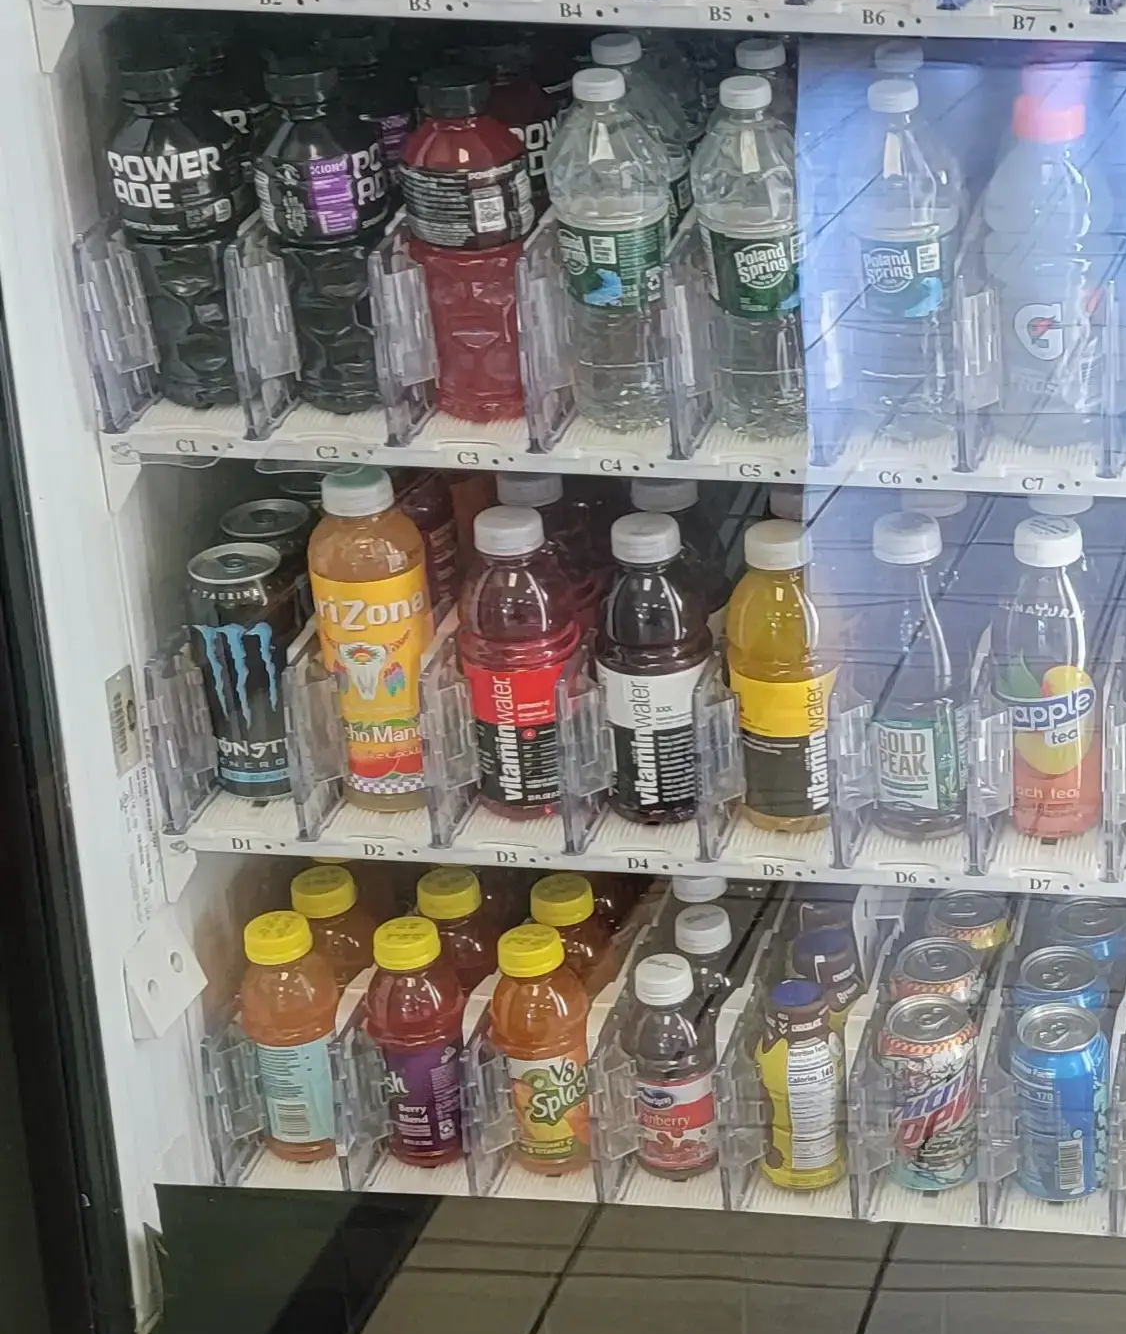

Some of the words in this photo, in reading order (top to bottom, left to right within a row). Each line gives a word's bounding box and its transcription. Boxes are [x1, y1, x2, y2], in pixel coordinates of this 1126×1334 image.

[559, 2, 583, 19] B4
[708, 5, 732, 22] B5
[862, 9, 886, 26] B6
[1012, 14, 1036, 32] B7
[107, 146, 223, 183] POWER
[112, 178, 175, 209] ADE
[733, 242, 786, 265] Poland
[862, 250, 910, 269] Poland
[737, 257, 789, 284] Spring
[865, 262, 914, 285] Spring
[1014, 303, 1064, 361] G
[175, 438, 198, 453] C1
[315, 445, 340, 460] C2
[456, 451, 480, 466] C3
[599, 459, 622, 472] C4
[739, 463, 762, 478] C5
[878, 470, 902, 485] C6
[1021, 476, 1044, 491] C7
[201, 588, 260, 602] TAURINE
[317, 589, 425, 631] riZona
[1014, 689, 1091, 730] apple
[878, 727, 926, 755] GOLD
[1050, 729, 1079, 745] tea
[219, 755, 286, 769] ENERG
[879, 747, 929, 776] PEAK
[1050, 786, 1081, 800] tea
[231, 837, 252, 851] D1
[363, 843, 386, 857] D2
[496, 850, 518, 863] D3
[627, 857, 649, 870] D4
[762, 864, 785, 877] D5
[894, 871, 918, 884] D6
[1029, 878, 1051, 891] D7
[548, 1056, 575, 1083] V8
[821, 1064, 835, 1079] 140
[1036, 1091, 1055, 1102] 170
[642, 1113, 691, 1130] anberry
